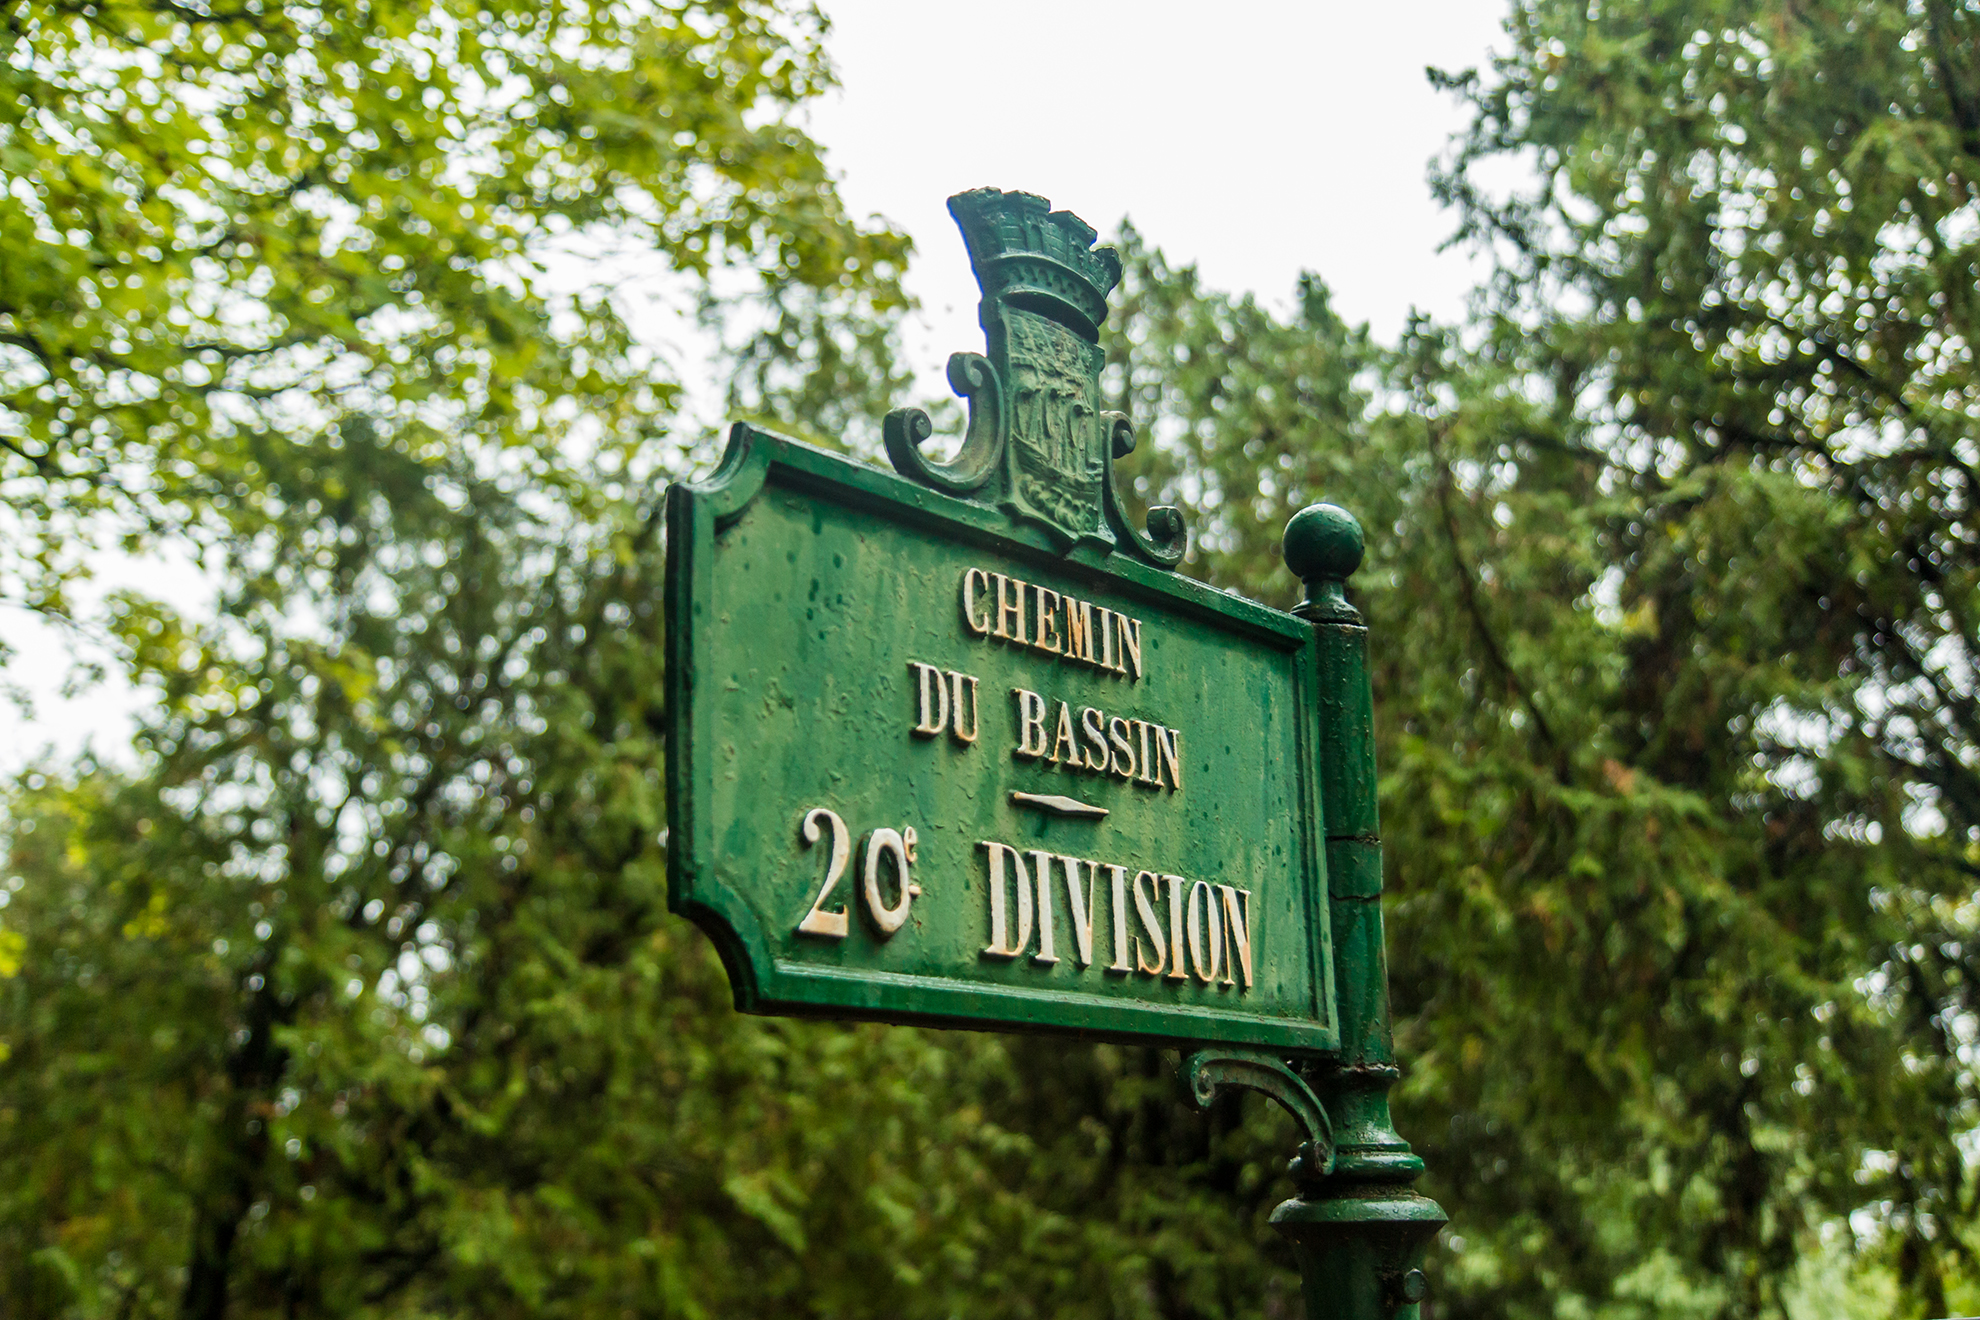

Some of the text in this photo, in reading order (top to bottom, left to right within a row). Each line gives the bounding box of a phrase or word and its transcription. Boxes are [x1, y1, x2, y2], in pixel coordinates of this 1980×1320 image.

[963, 567, 1142, 679] CHEMIN
[908, 662, 1180, 790] DU BASSIN
[981, 840, 1253, 988] DIVISION
